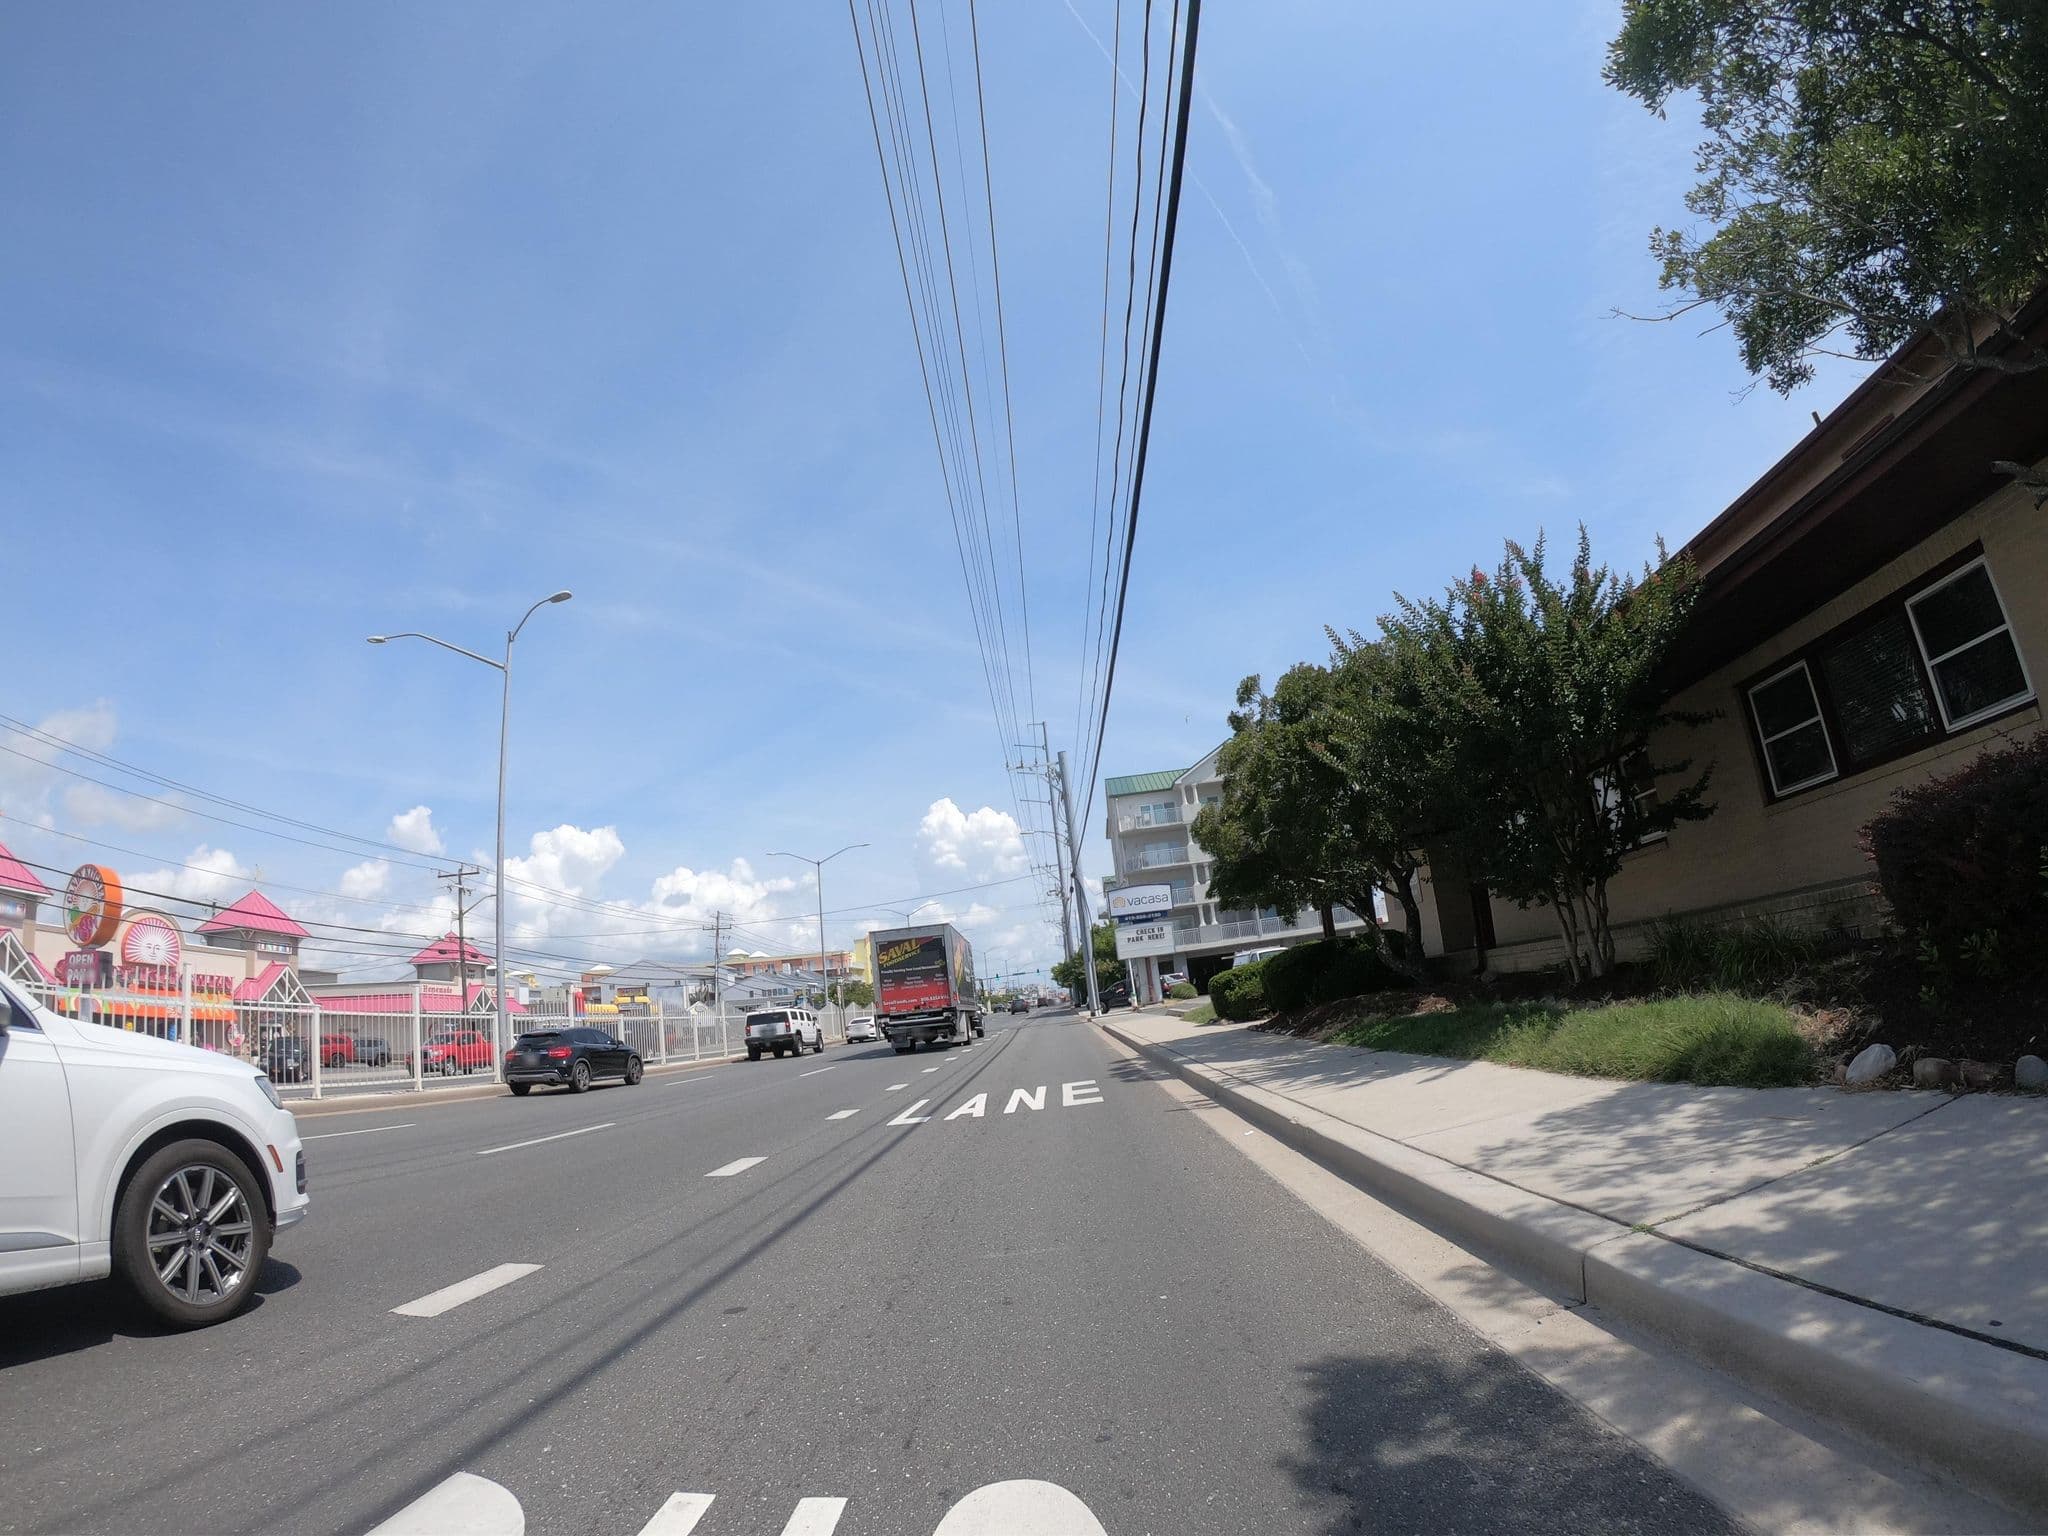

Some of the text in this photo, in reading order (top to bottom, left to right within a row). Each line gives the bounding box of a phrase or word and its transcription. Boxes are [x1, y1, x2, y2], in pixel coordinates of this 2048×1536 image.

[1127, 894, 1168, 906] vacasa
[1136, 927, 1155, 935] CHECK
[879, 938, 920, 964] SAVAL
[69, 953, 94, 964] OPEN
[886, 1079, 1104, 1126] LANE
